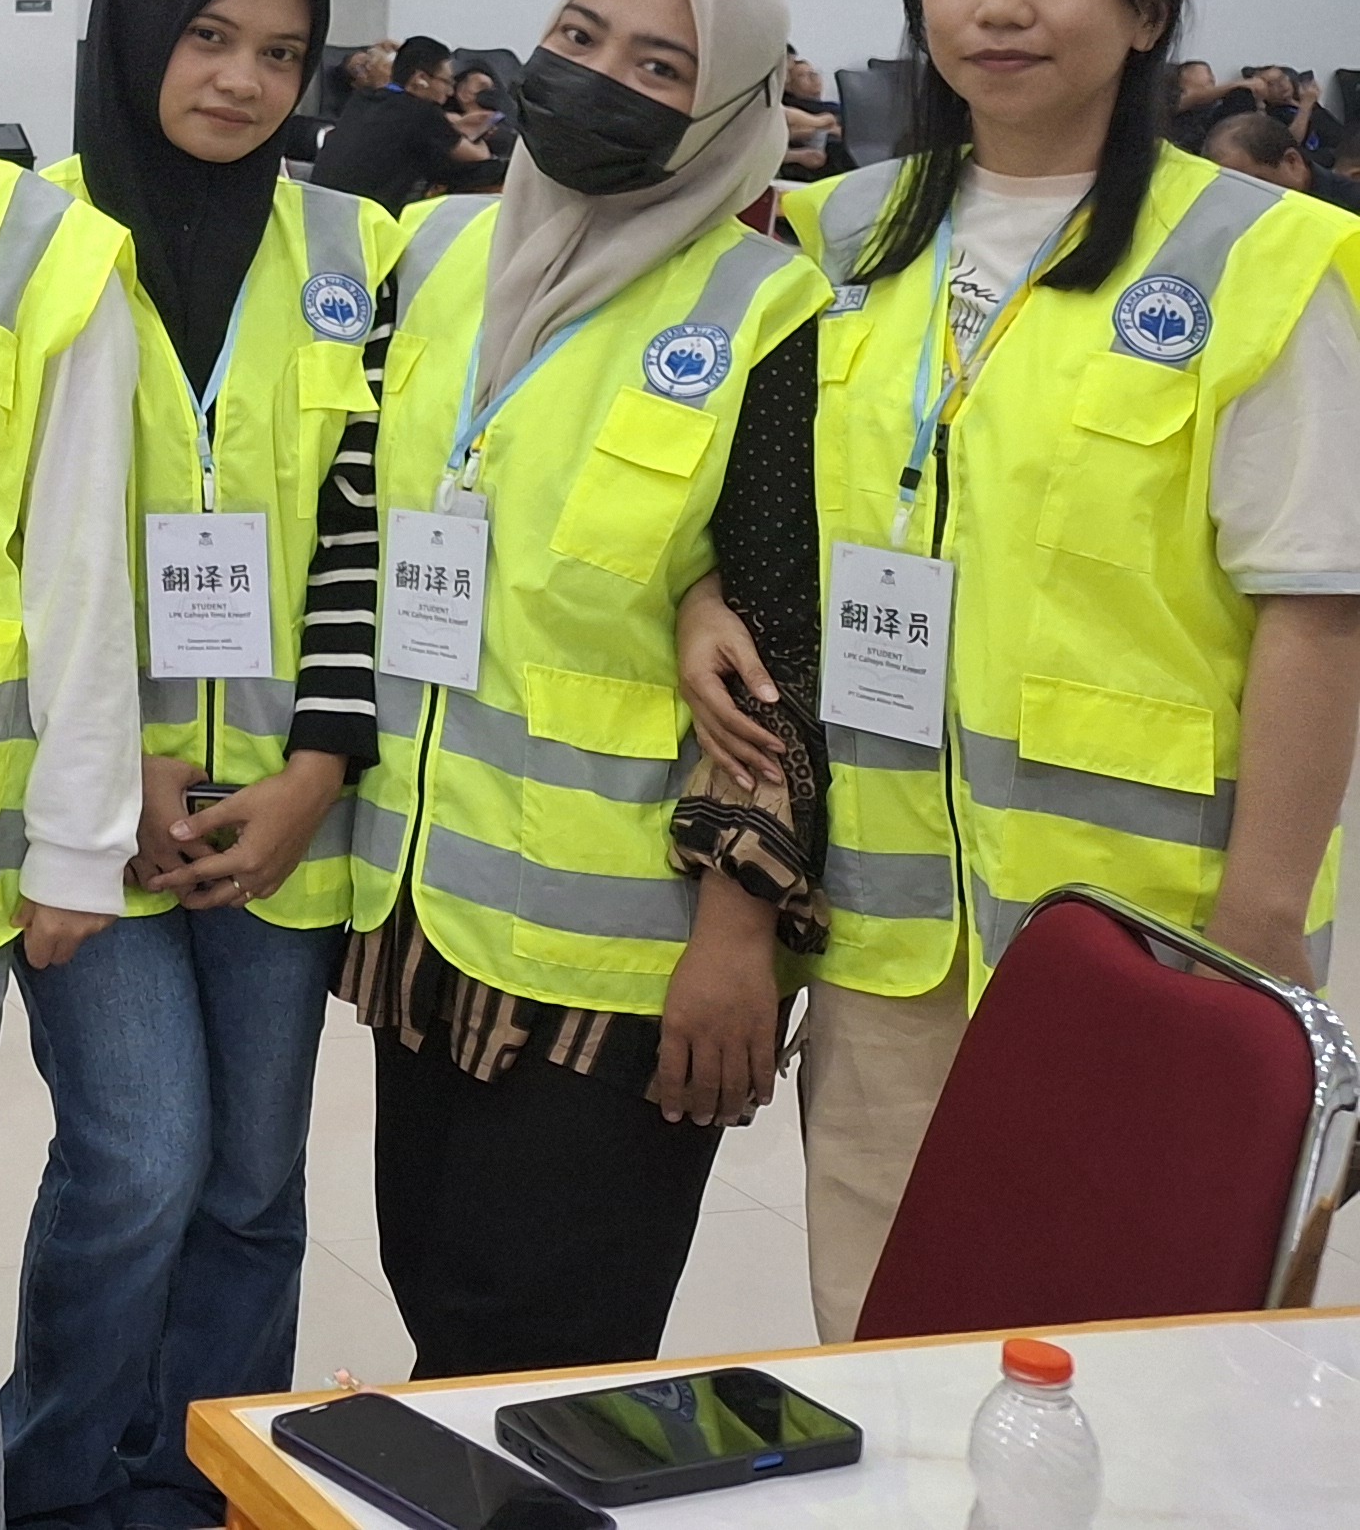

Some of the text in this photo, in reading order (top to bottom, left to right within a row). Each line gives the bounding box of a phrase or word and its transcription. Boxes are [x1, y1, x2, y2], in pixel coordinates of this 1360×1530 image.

[162, 564, 250, 593] 翻译员
[395, 560, 471, 600] 翻译员
[839, 600, 929, 647] 翻译员
[867, 647, 903, 661] STUDENT
